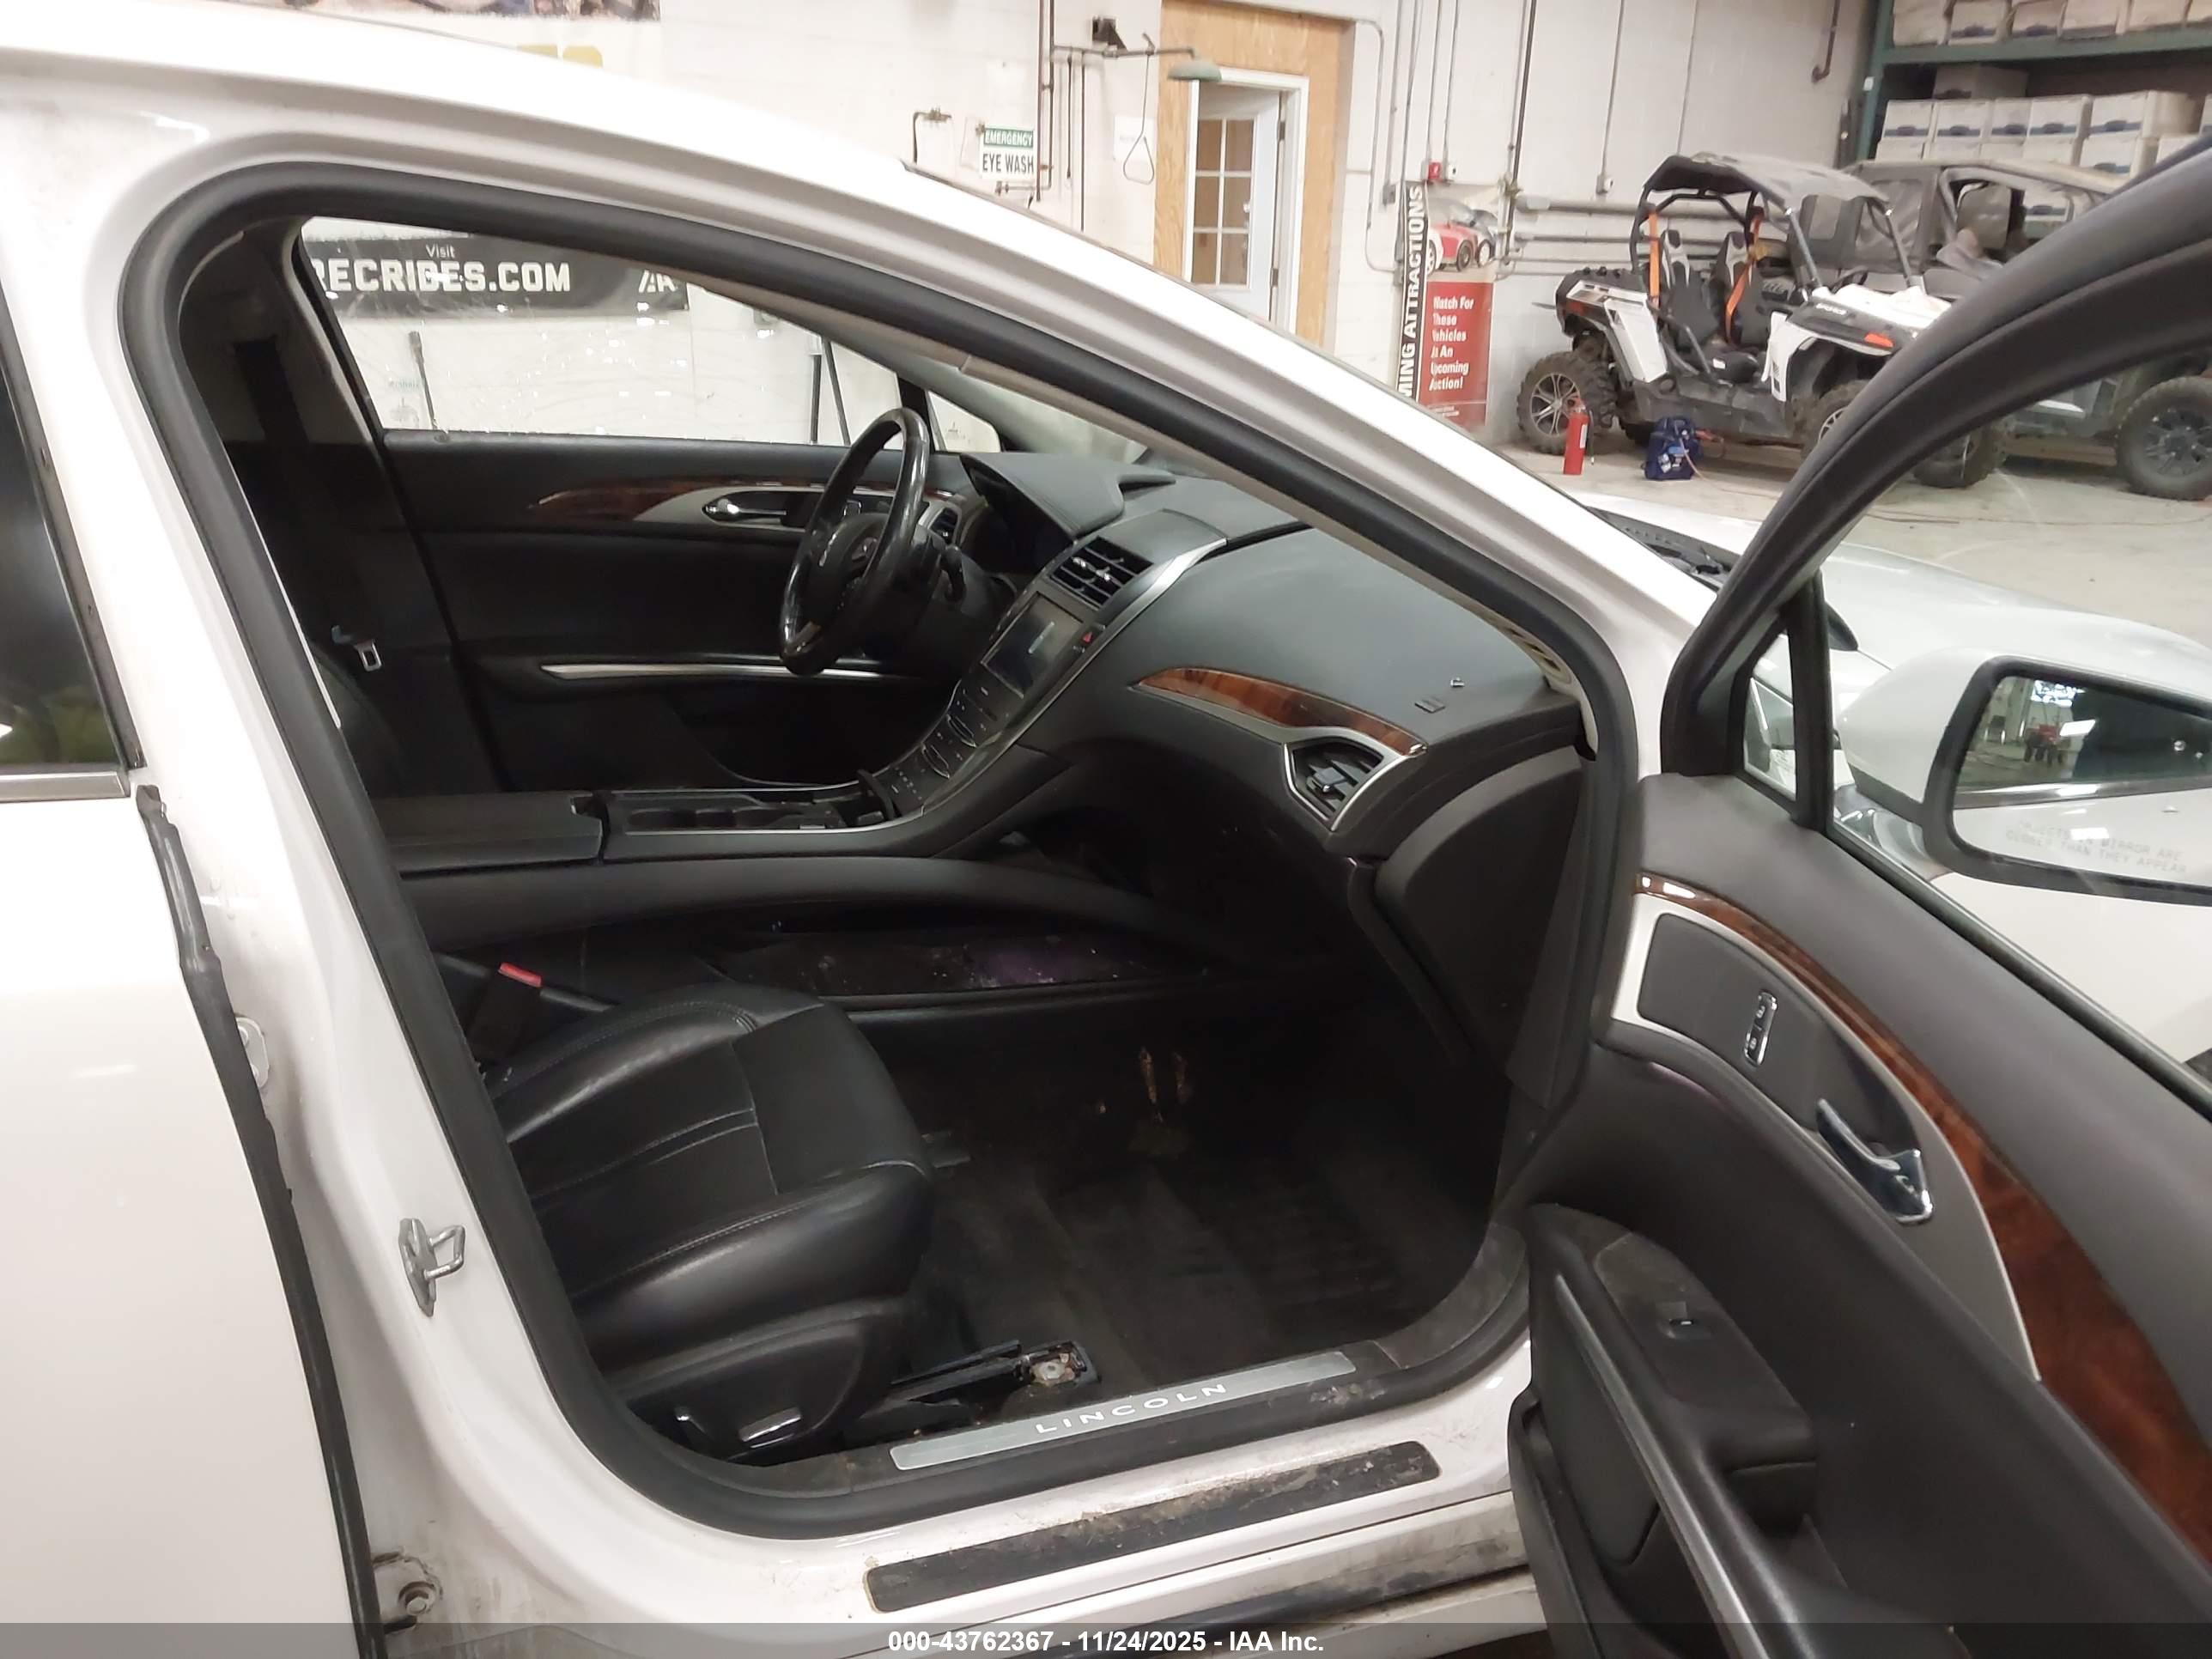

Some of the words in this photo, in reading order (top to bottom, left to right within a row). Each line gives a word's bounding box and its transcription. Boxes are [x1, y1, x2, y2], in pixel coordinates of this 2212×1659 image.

[985, 131, 1033, 146] EMERGENCY
[982, 154, 1001, 172] EYE
[1005, 155, 1034, 174] WASH
[425, 244, 456, 258] Visit
[1404, 185, 1425, 338] ATTRACTIONS
[1460, 296, 1475, 310] For
[1432, 313, 1457, 326] These
[1431, 328, 1467, 342] Vehicles
[1440, 344, 1454, 358] An
[1431, 361, 1469, 376] Upcoming
[1429, 376, 1464, 392] Auction!
[1036, 1383, 1226, 1433] LINCOLN
